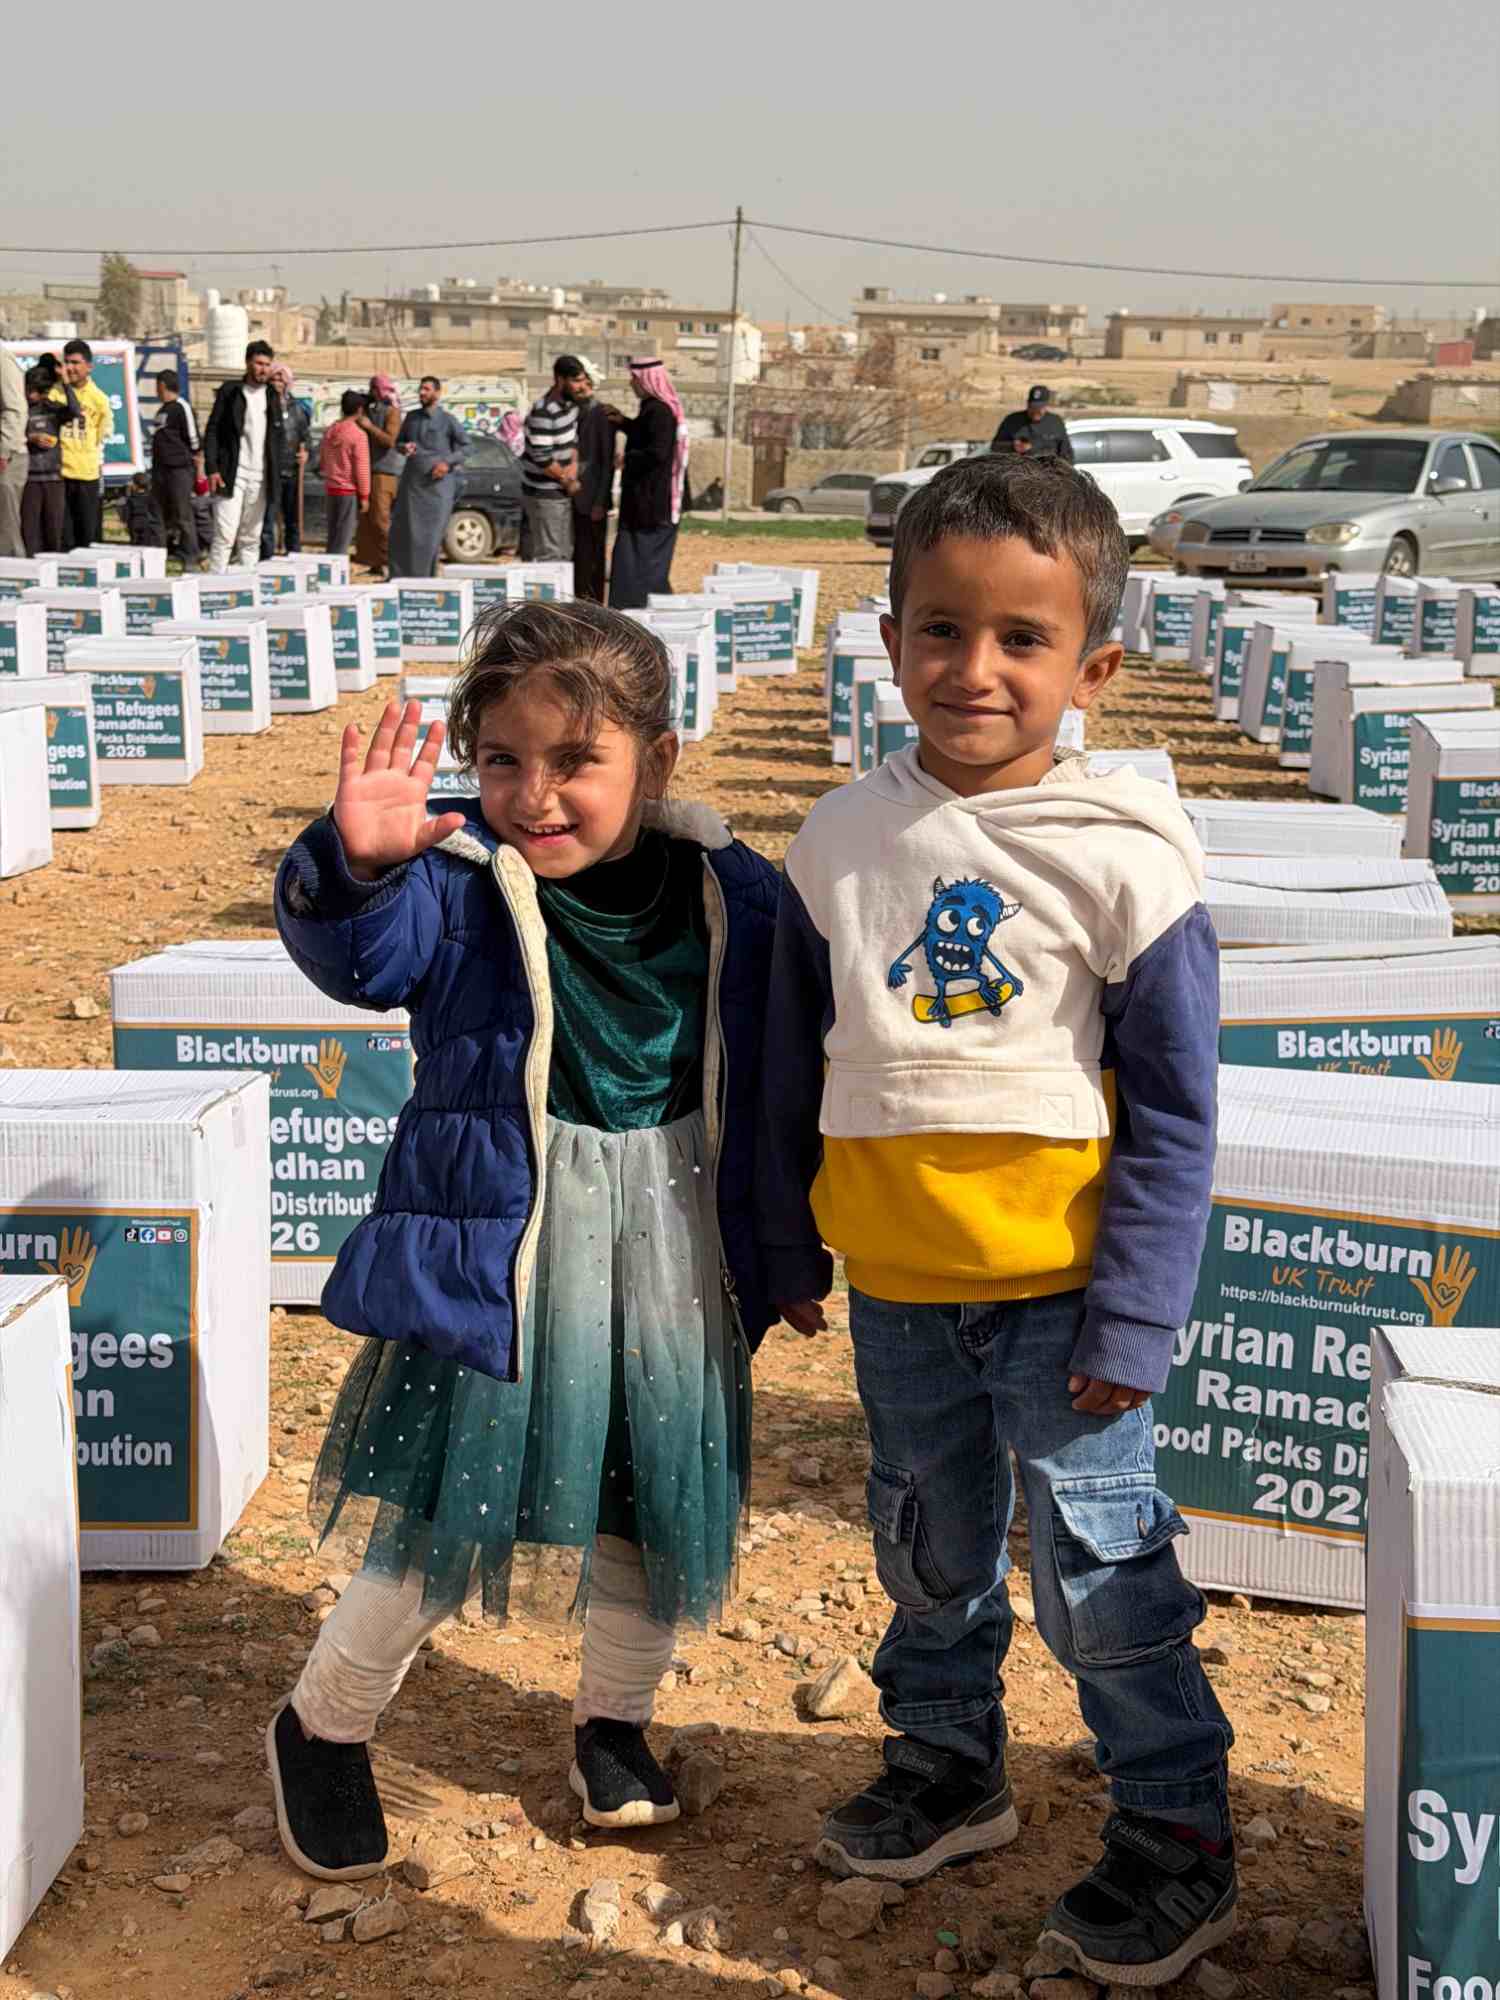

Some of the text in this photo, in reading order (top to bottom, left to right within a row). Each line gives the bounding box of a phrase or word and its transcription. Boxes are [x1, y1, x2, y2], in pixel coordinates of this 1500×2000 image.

[96, 718, 163, 731] amadhan
[115, 701, 179, 719] Refugees
[48, 745, 86, 762] gees
[105, 745, 147, 758] 2026
[1389, 784, 1408, 797] Pac
[1432, 818, 1489, 843] Syrian
[1436, 862, 1458, 875] ood
[176, 1034, 318, 1063] Blackburn
[1277, 1029, 1432, 1059] Blackburn
[271, 1108, 400, 1154] efugees
[271, 1152, 365, 1180] dhan
[272, 1191, 377, 1216] Distribut
[272, 1222, 320, 1252] 26
[1223, 1214, 1433, 1278] Blackburn
[1271, 1264, 1376, 1298] UK Trust
[1220, 1284, 1426, 1327] https://blackburnuktrust.org
[70, 1331, 174, 1380] gees
[1172, 1313, 1295, 1370] yrian
[1196, 1369, 1370, 1431] Ramad
[76, 1434, 172, 1467] bution
[1153, 1423, 1211, 1455] ood
[1221, 1426, 1322, 1472] Packs
[1252, 1473, 1368, 1526] 202
[1408, 1789, 1500, 1885] Sy
[1408, 1954, 1500, 2000] Foo
